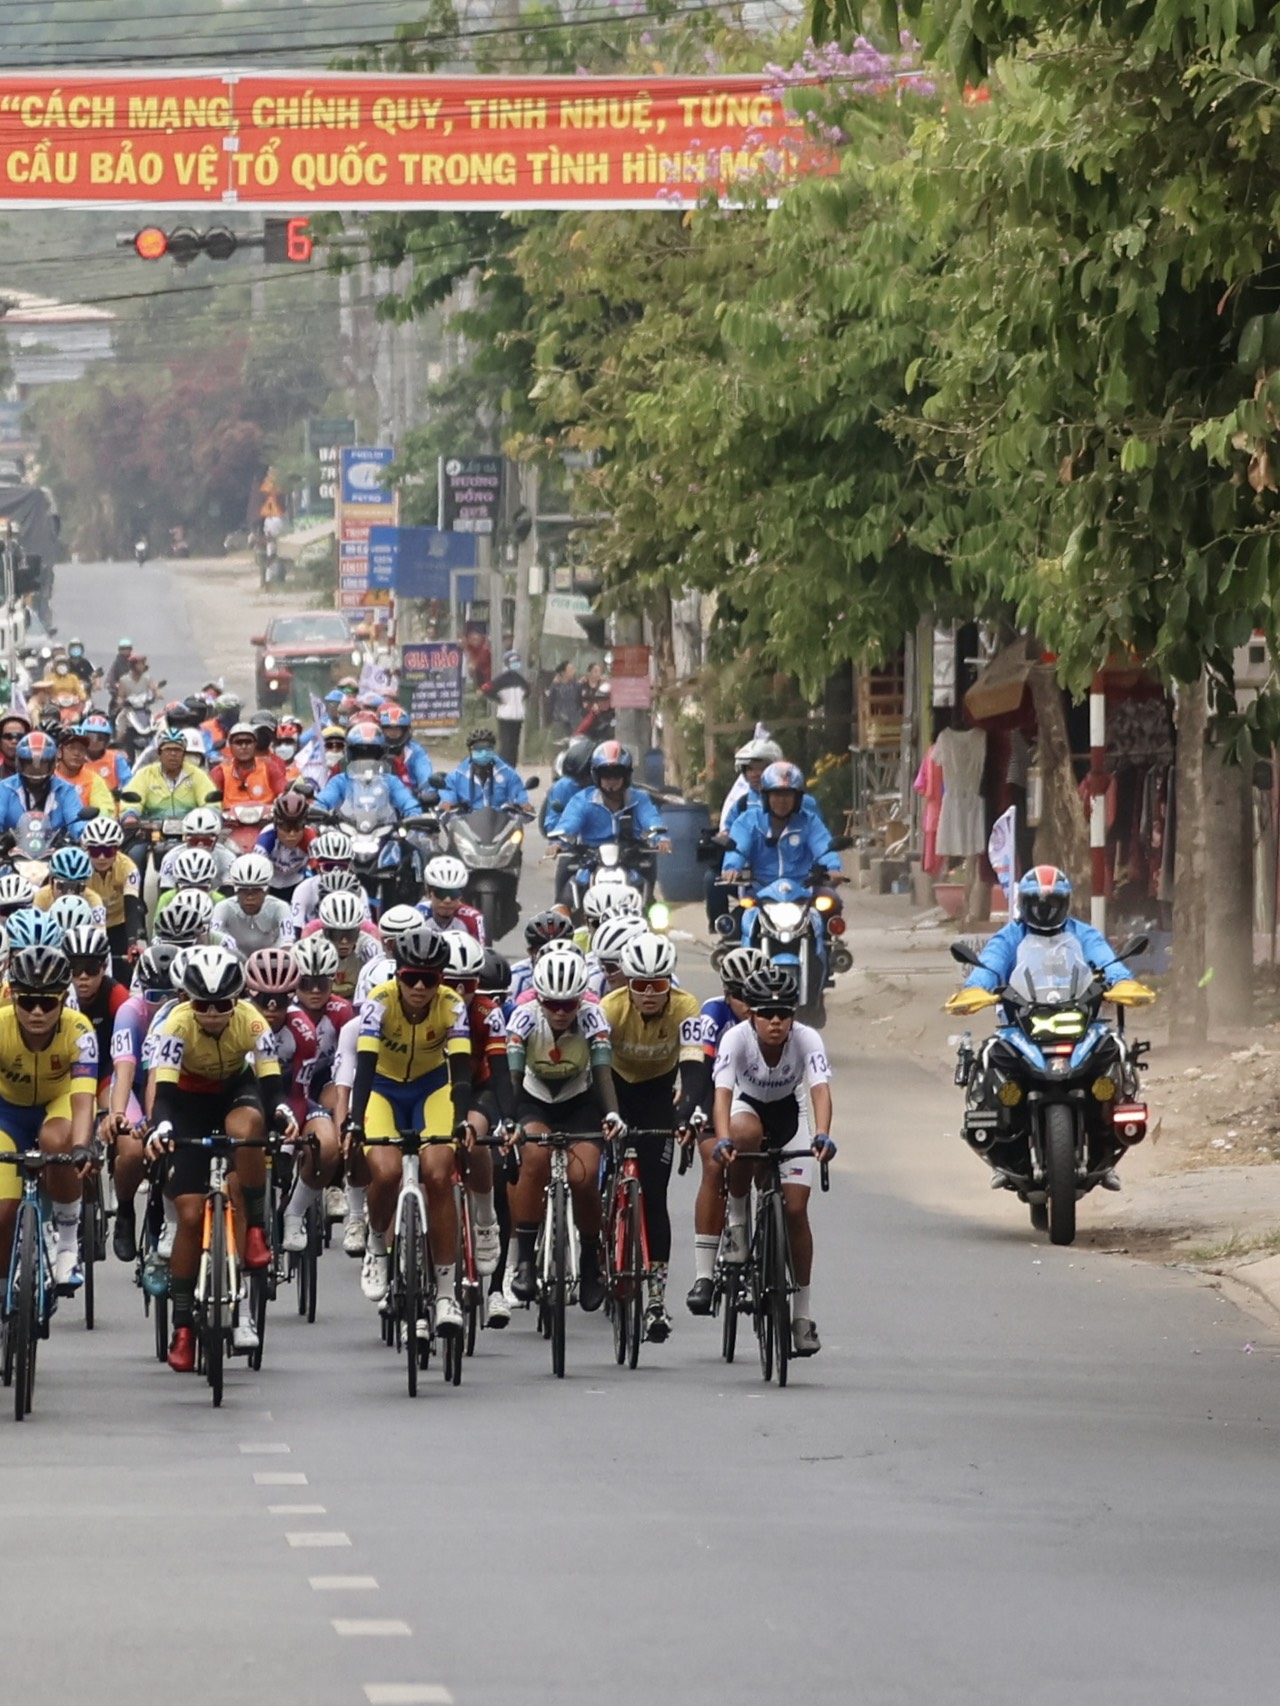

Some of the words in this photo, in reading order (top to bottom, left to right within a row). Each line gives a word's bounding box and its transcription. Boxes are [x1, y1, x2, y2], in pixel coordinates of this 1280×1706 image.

[252, 89, 360, 130] CHÍNH
[372, 97, 453, 136] QUY,
[464, 98, 547, 129] TINH
[560, 91, 667, 135] NHUỆ,
[6, 138, 77, 184] CẦU
[90, 140, 164, 185] BẢO
[173, 145, 219, 192] VỆ
[233, 137, 280, 186] TỔ
[291, 141, 388, 192] QUỐC
[399, 152, 516, 186] TRONG
[527, 145, 609, 186] TÌNH
[622, 144, 707, 186] HÌNH
[286, 217, 313, 261] 6
[363, 1003, 375, 1025] 2
[291, 1017, 315, 1042] CSK
[682, 1020, 701, 1041] 65
[161, 1039, 184, 1065] 45
